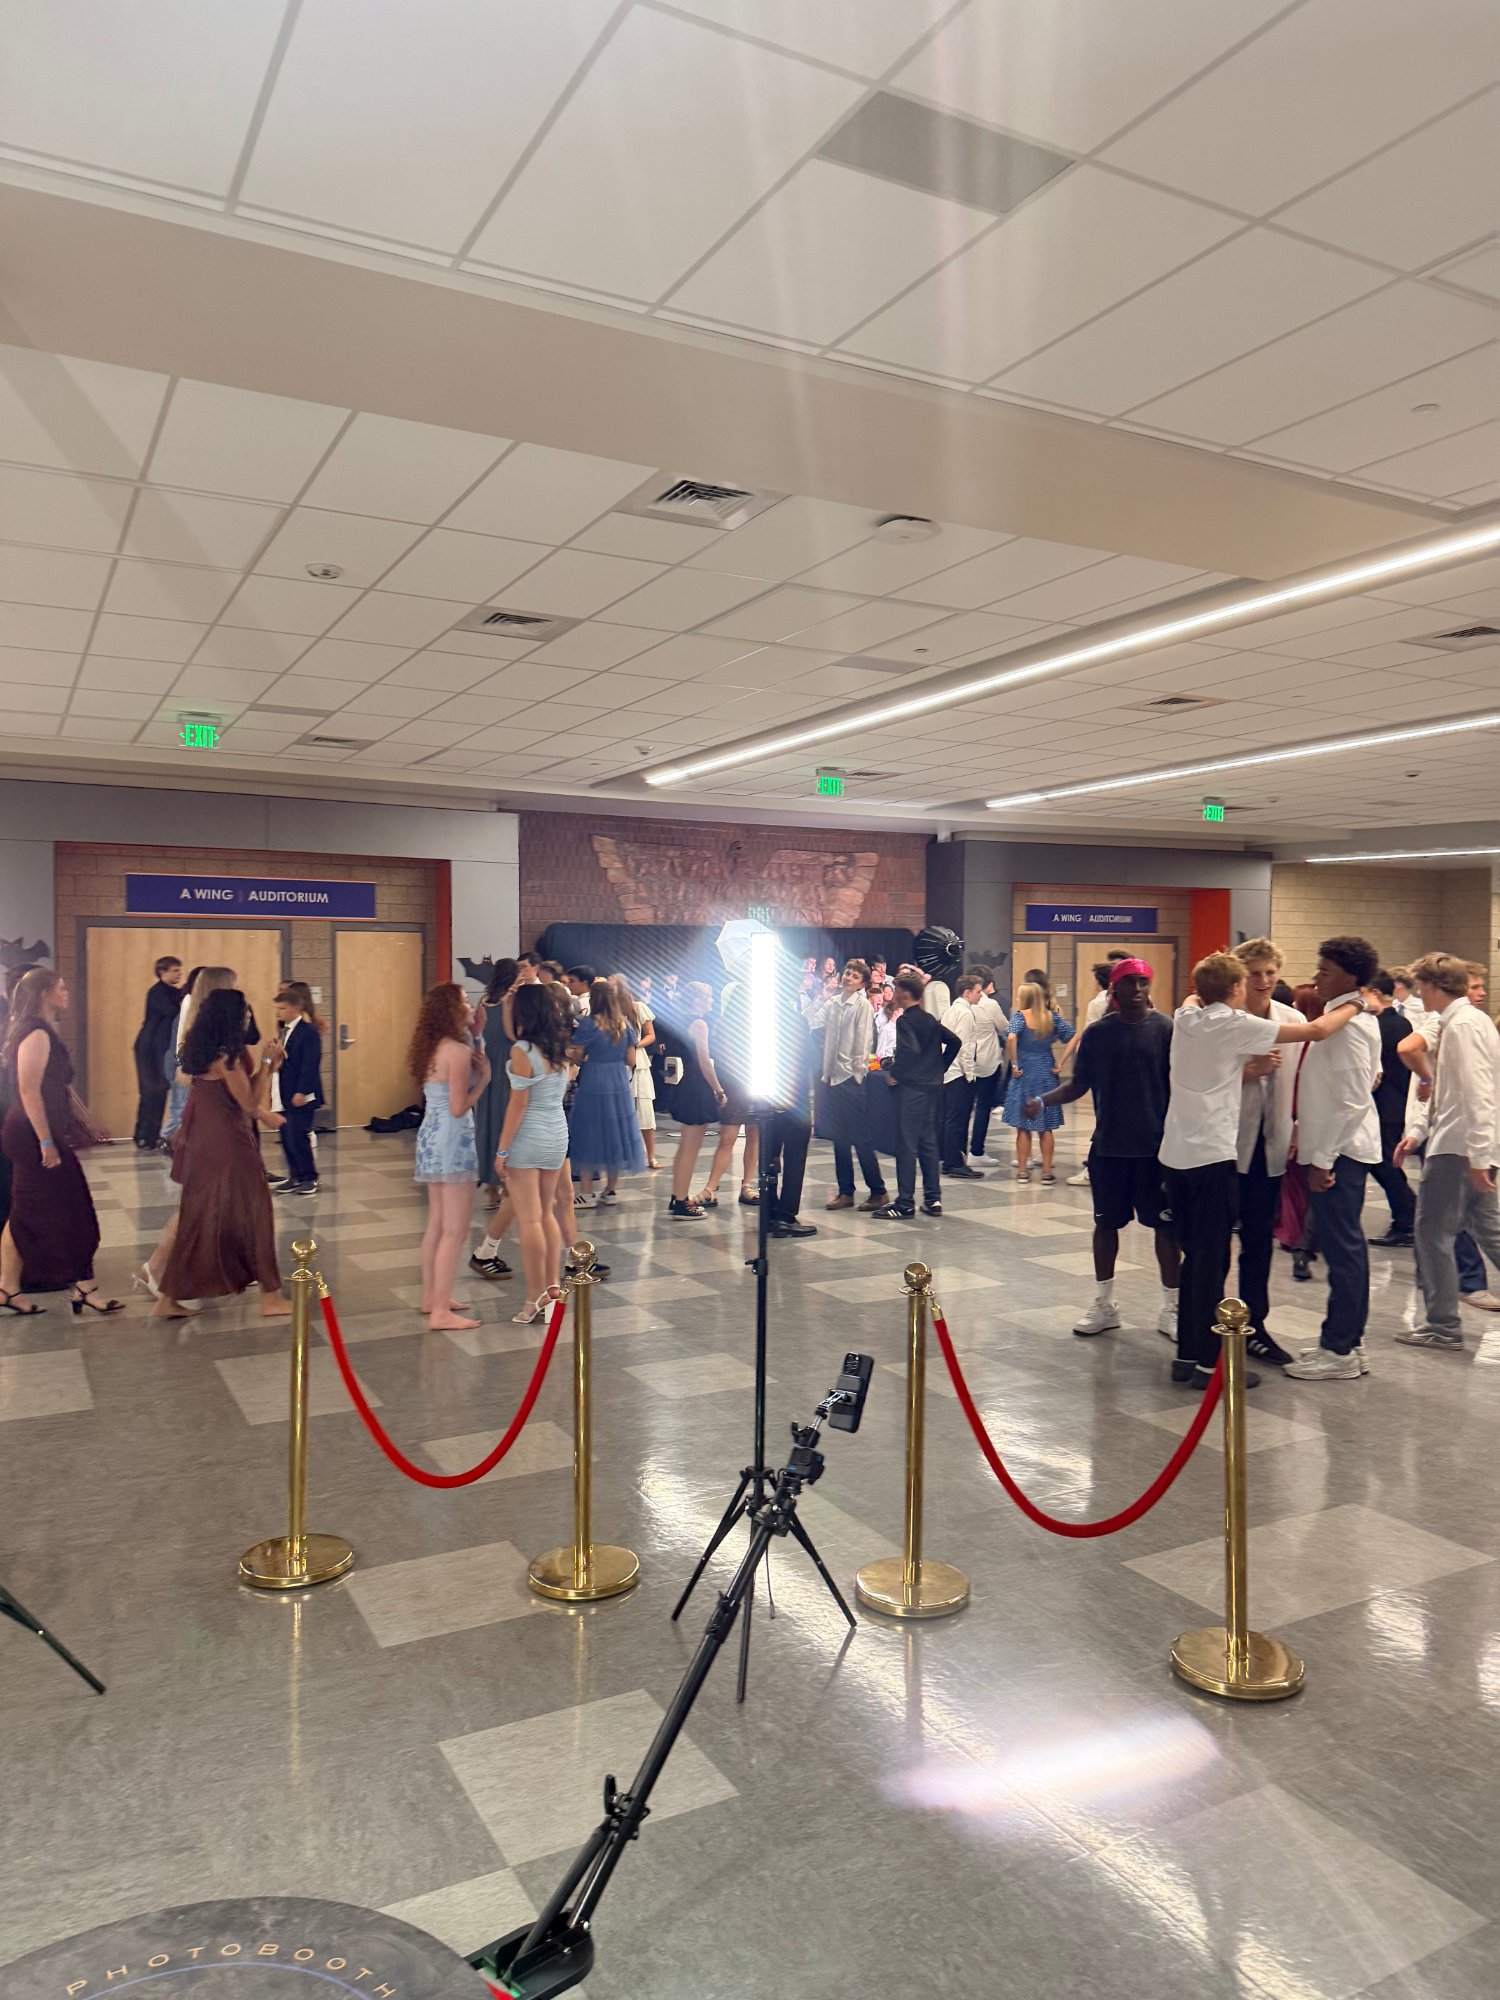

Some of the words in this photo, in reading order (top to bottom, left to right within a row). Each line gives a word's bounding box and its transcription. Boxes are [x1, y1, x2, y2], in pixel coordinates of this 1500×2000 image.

[185, 724, 215, 748] EXIT
[821, 776, 841, 796] EXIT
[179, 888, 191, 899] A
[195, 888, 234, 900] WING
[248, 890, 329, 903] AUDITORIUM
[1061, 914, 1082, 922] WING
[66, 1943, 396, 1998] PHOTOBOOTH
